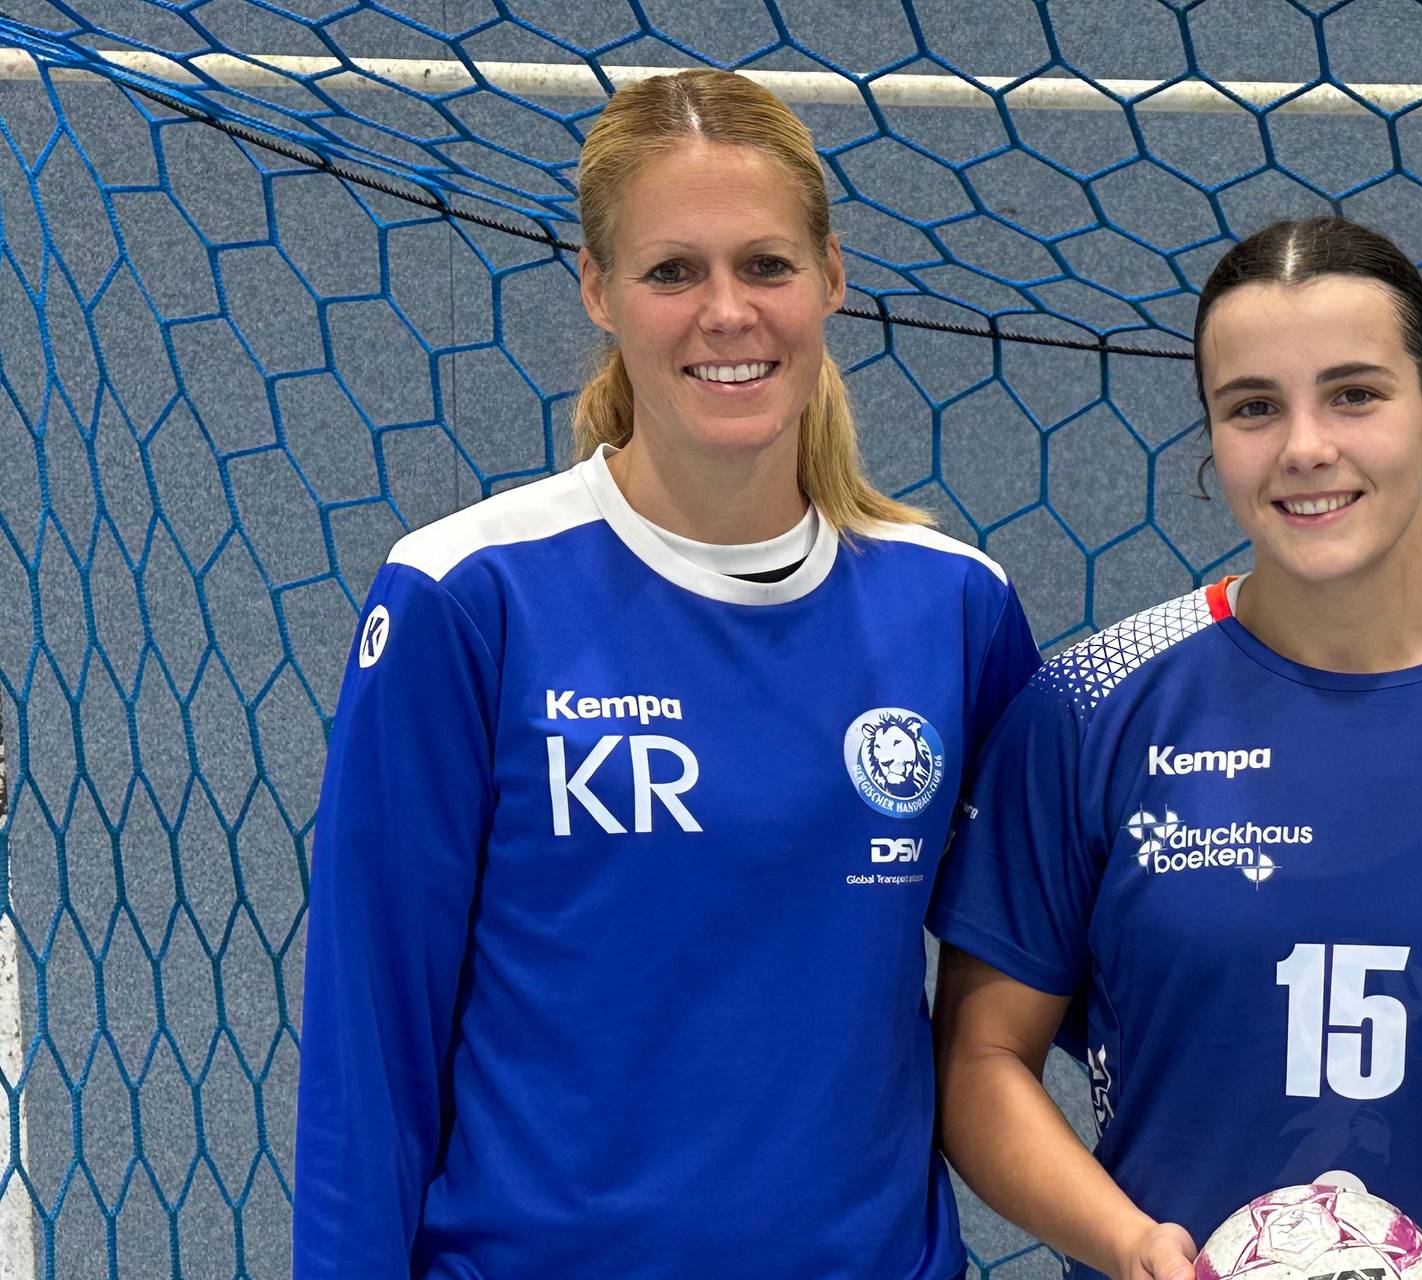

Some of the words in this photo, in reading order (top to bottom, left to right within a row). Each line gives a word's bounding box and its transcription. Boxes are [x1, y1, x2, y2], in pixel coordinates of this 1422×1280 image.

[546, 689, 683, 725] Kempa
[1149, 745, 1271, 778] Kempa
[546, 735, 704, 836] KR
[870, 838, 923, 863] DSV
[1169, 822, 1313, 849] druckhaus
[1154, 844, 1254, 873] boeken
[846, 874, 875, 885] Global
[1276, 943, 1411, 1100] 15
